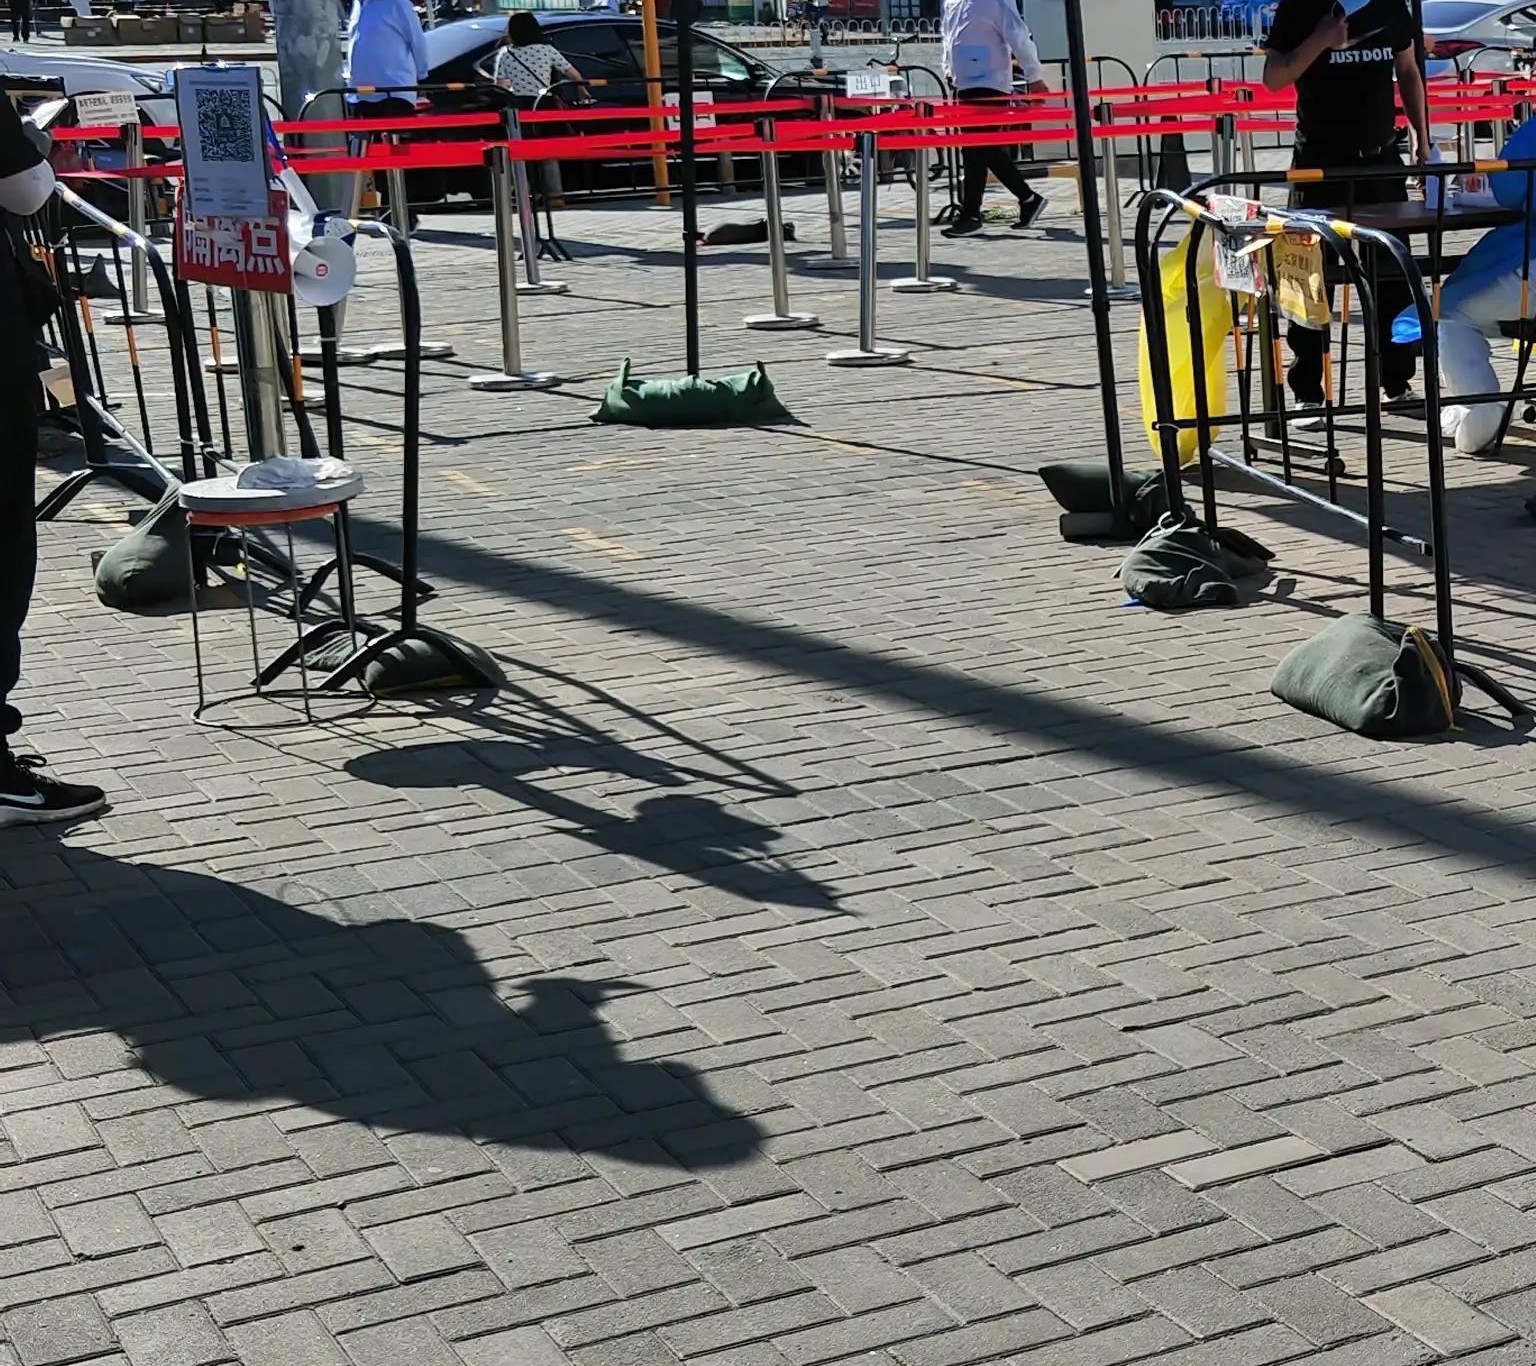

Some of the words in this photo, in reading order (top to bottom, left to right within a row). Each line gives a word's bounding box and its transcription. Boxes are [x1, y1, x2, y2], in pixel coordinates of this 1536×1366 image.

[1329, 51, 1360, 63] JUST
[1362, 48, 1382, 61] DO
[183, 210, 285, 275] 隔离点
